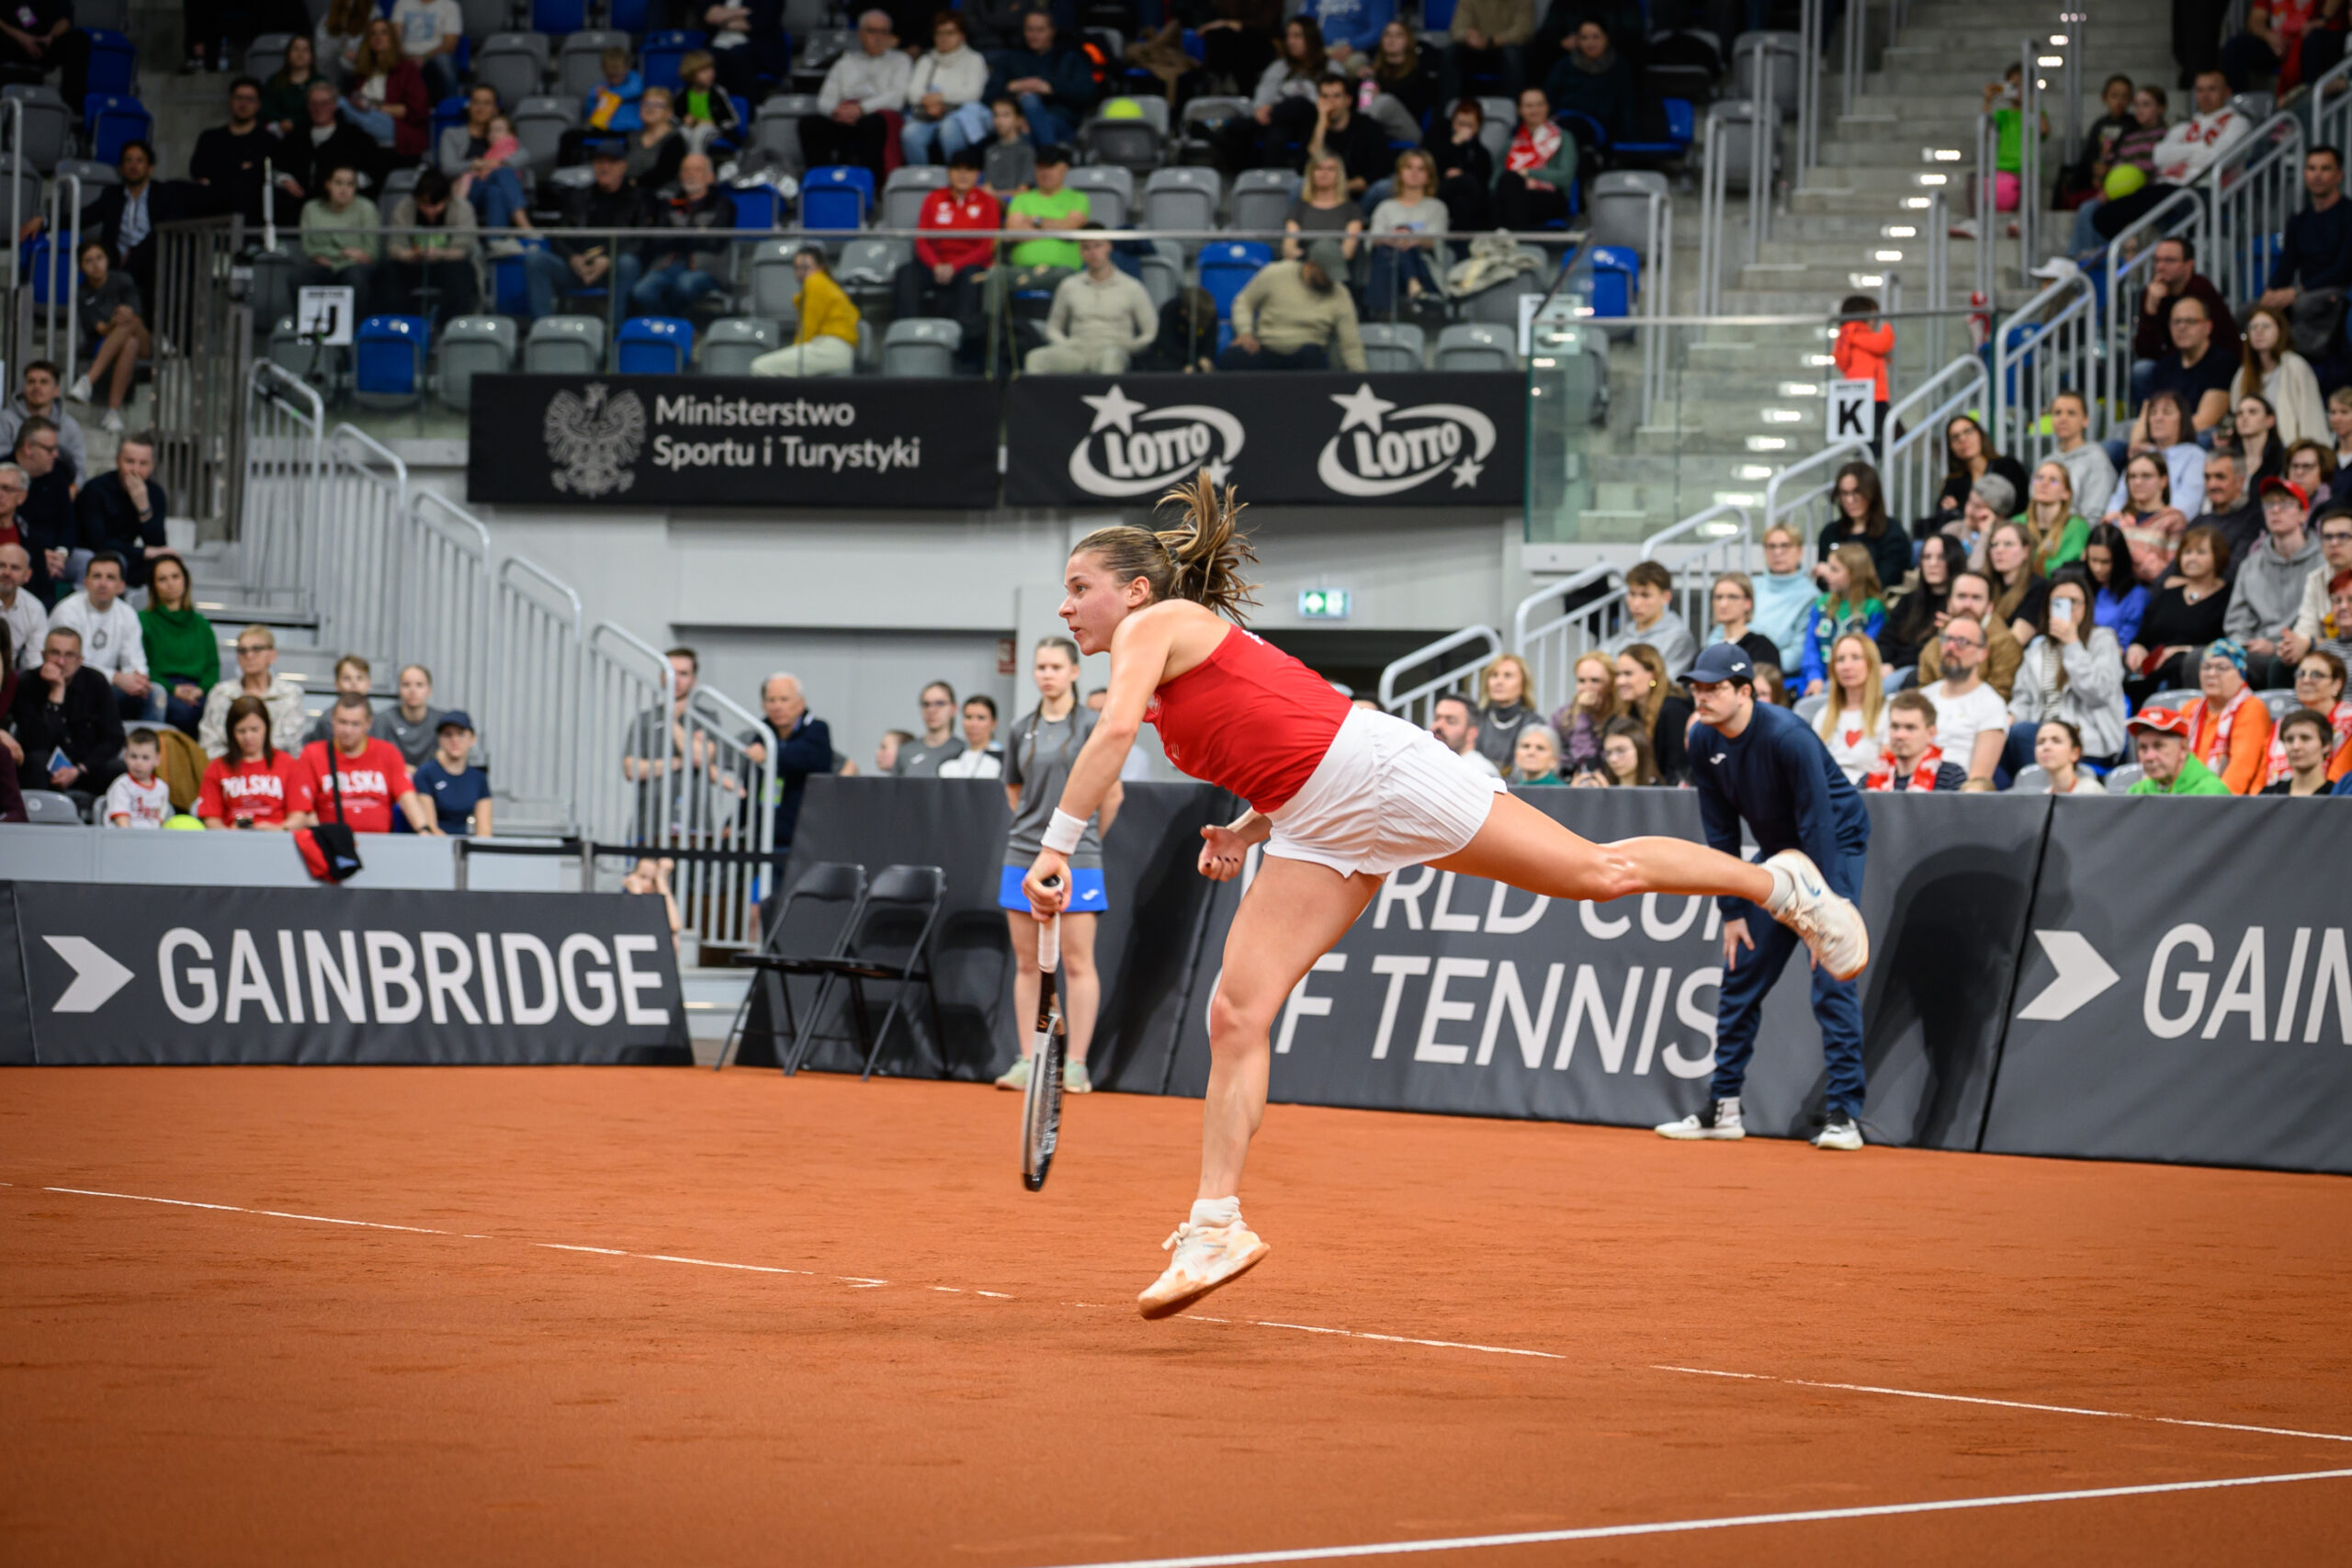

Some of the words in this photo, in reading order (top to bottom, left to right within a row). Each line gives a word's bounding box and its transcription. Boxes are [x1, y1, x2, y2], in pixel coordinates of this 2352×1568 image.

[654, 394, 856, 426] Ministerstwo
[1838, 398, 1865, 436] K
[652, 434, 756, 471] Sportu
[763, 435, 773, 467] i
[779, 435, 920, 474] Turystyki
[1104, 423, 1212, 479] LOTTO
[1352, 422, 1463, 478] LOTTO
[220, 774, 284, 800] POLSKA
[157, 927, 670, 1026] GAINBRIDGE
[1205, 953, 1348, 1054] F
[1370, 954, 1724, 1079] TENNIS
